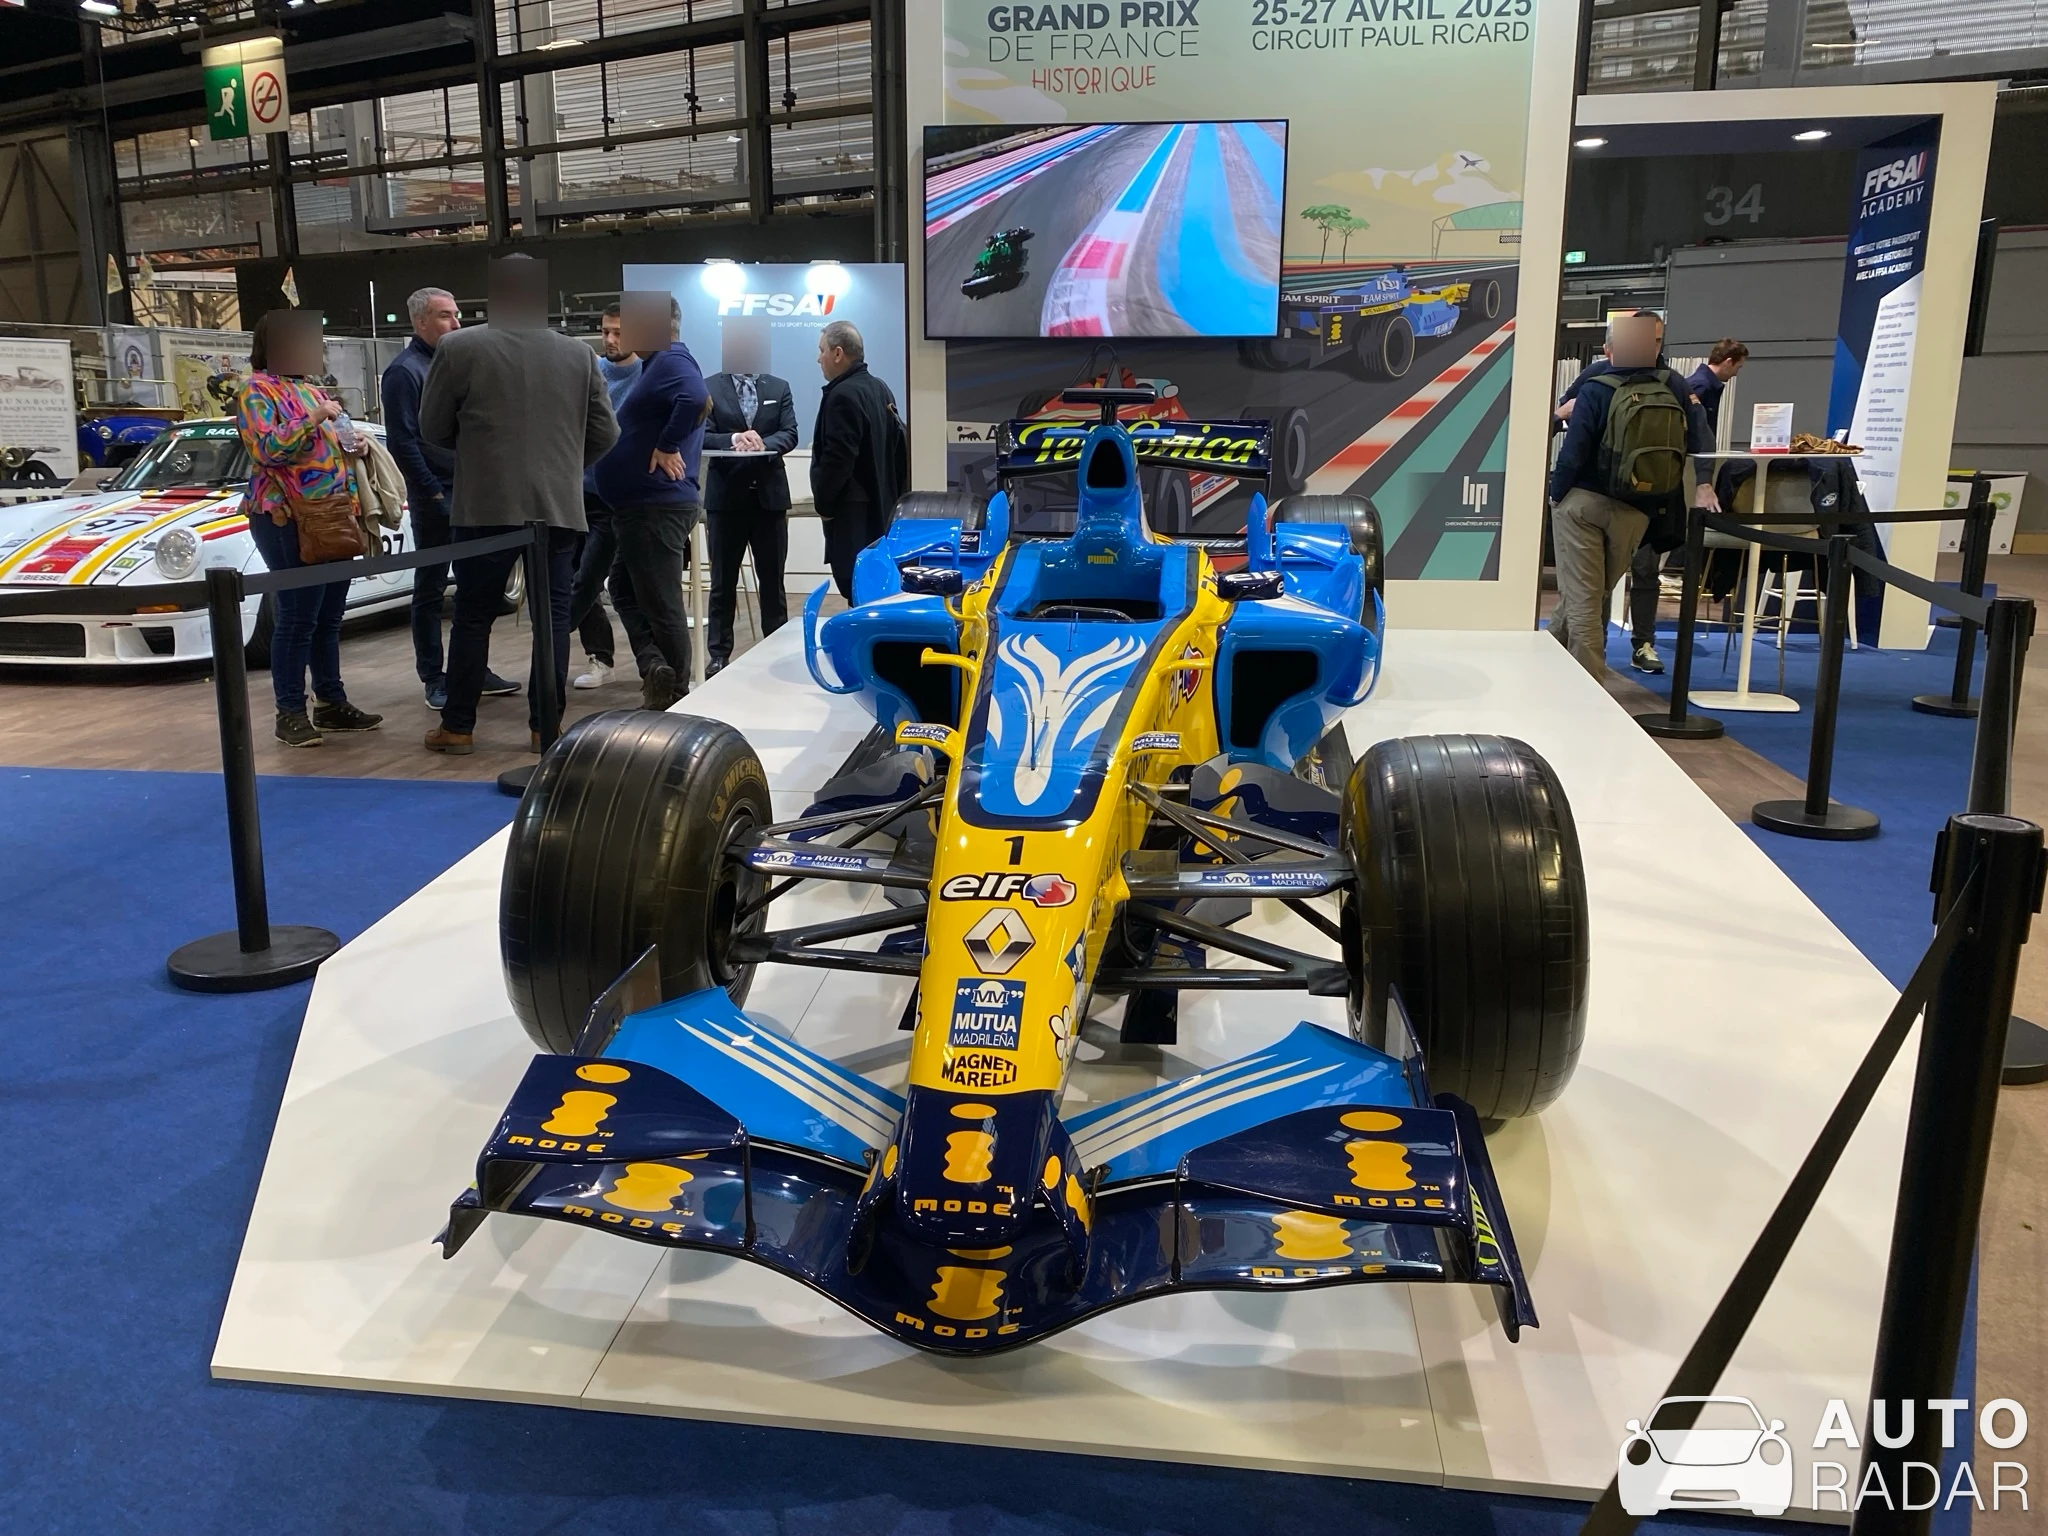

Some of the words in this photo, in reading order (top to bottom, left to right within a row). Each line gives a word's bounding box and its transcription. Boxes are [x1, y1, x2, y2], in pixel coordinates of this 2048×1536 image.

[988, 3, 1110, 32] GRAND
[1120, 0, 1200, 28] PRIX
[1251, 0, 1337, 25] 25-27
[1345, 0, 1446, 23] AVRIL
[1455, 0, 1532, 19] 2025
[988, 35, 1035, 62] DE
[1050, 29, 1200, 61] FRANCE
[1251, 28, 1354, 50] CIRCUIT
[1360, 24, 1424, 48] PAUL
[1431, 21, 1530, 45] RICARD
[1031, 65, 1156, 94] HISTORIQUE
[1862, 154, 1919, 198] FFSA
[1703, 183, 1766, 226] 34
[1860, 185, 1924, 219] ACADEMY
[718, 293, 822, 316] FFSA
[1304, 295, 1341, 304] SPIRIT
[1361, 293, 1382, 305] TEAM
[81, 518, 147, 532] 97
[1087, 554, 1115, 565] PUMA
[23, 573, 60, 582] BIESSE
[903, 727, 946, 738] MUTUA
[1134, 737, 1178, 745] MUTUA
[814, 855, 863, 864] MUTUA
[1004, 835, 1025, 866] 1
[941, 873, 1026, 899] elf
[954, 1012, 1017, 1033] MUTUA
[952, 1032, 1015, 1048] MADRILEÑA
[941, 1054, 1017, 1079] MAGNETI
[941, 1064, 1017, 1087] MARELLI
